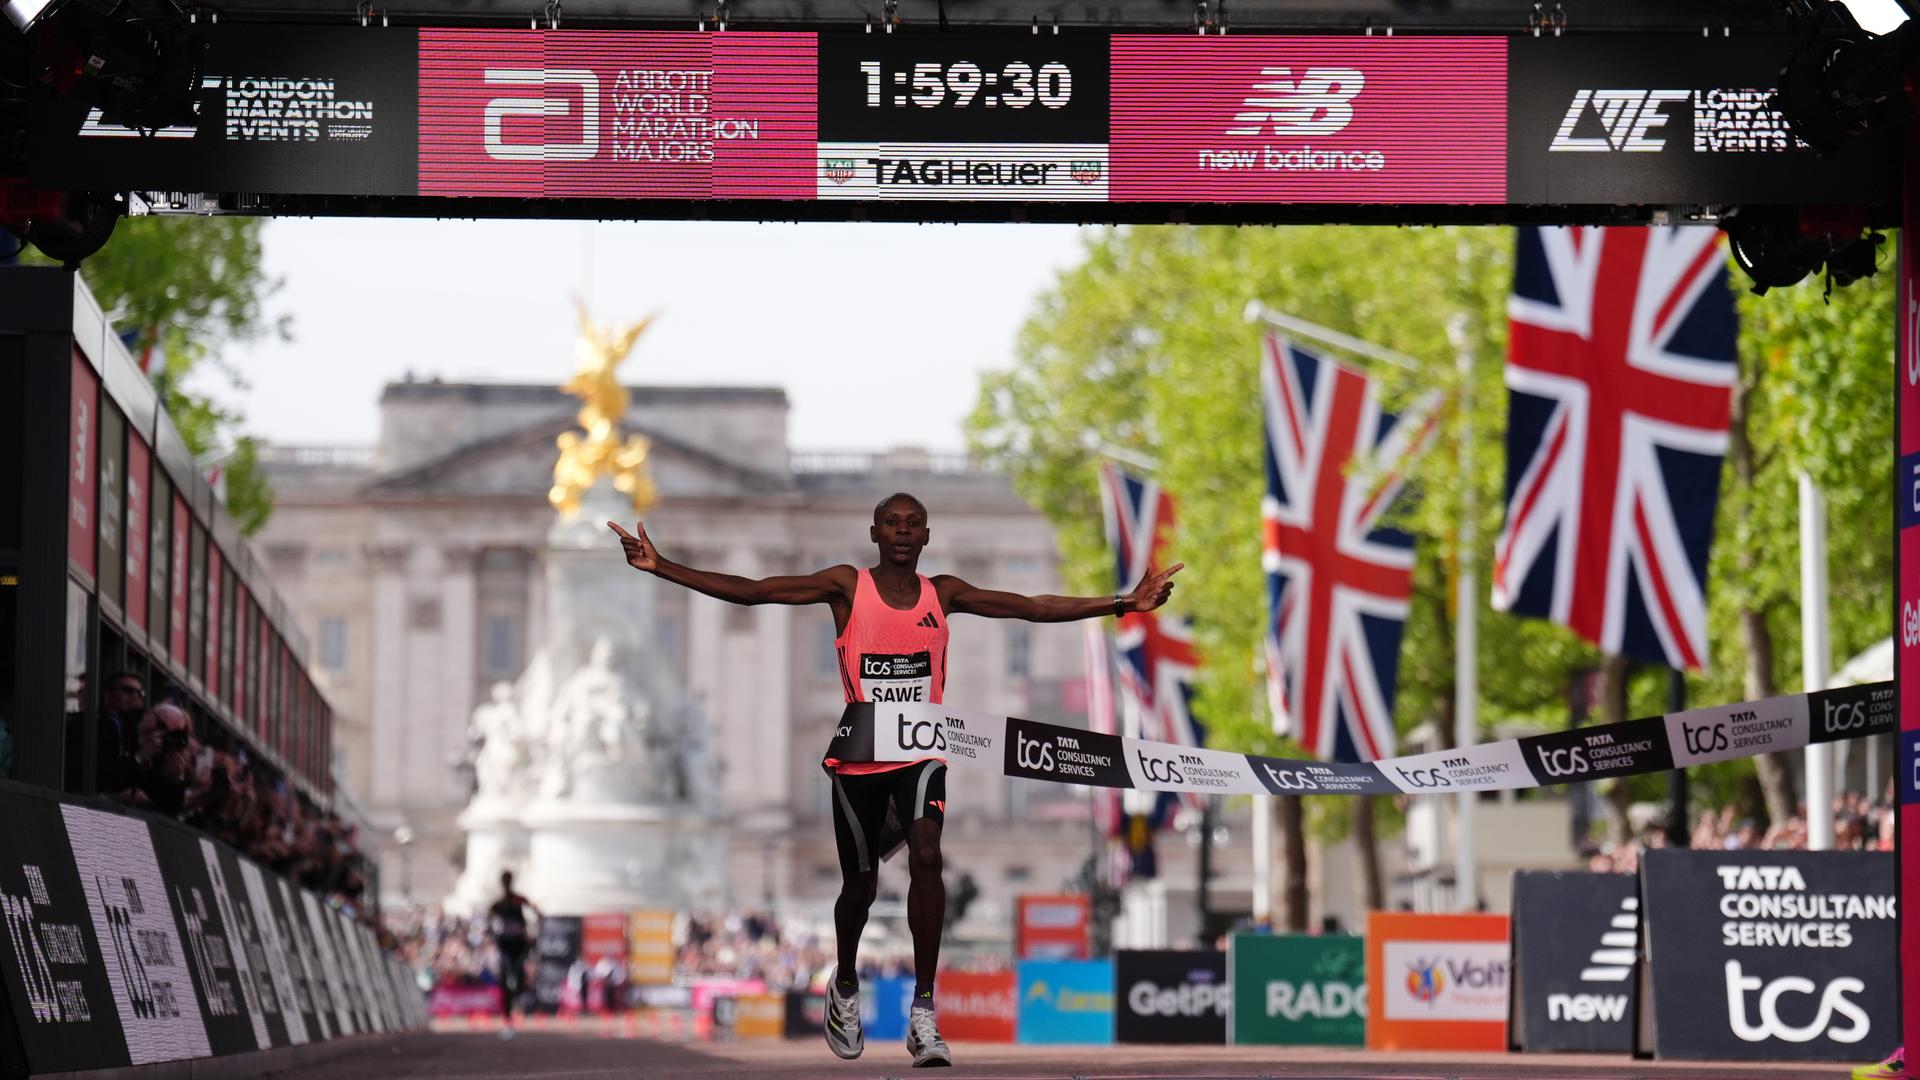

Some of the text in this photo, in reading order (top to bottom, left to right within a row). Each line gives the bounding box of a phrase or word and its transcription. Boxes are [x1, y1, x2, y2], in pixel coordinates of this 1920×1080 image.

[226, 76, 335, 98] LONDON
[613, 69, 714, 91] ABBOTT
[861, 61, 1072, 108] 1:59:30
[226, 100, 373, 119] MARATHON
[612, 93, 709, 115] WORLD
[612, 117, 759, 140] MARATHON
[1694, 110, 1791, 129] MARAT
[226, 120, 320, 141] EVENTS
[1694, 130, 1788, 152] EVENTS
[612, 141, 715, 162] MAJORS
[1199, 145, 1385, 171] new balance
[865, 657, 891, 675] tcs
[872, 686, 923, 702] SAWE
[945, 716, 965, 730] TATA
[1729, 710, 1758, 723] TATA
[1824, 699, 1865, 733] tcs
[898, 713, 947, 751] tcs
[1731, 717, 1794, 737] CONSULTANCY
[947, 730, 992, 748] CONSULTANCY
[1056, 736, 1080, 750] TATA
[1585, 733, 1614, 747] TATA
[1682, 721, 1729, 755] tcs
[1733, 733, 1773, 749] SERVICES
[949, 743, 977, 759] SERVICES
[1017, 730, 1054, 772] tcs
[1056, 749, 1112, 767] CONSULTANCY
[1178, 754, 1204, 766] TATA
[1589, 740, 1652, 760] CONSULTANCY
[1058, 763, 1096, 777] SERVICES
[1137, 749, 1184, 784] tcs
[1441, 757, 1471, 769] TATA
[1448, 762, 1510, 778] CONSULTANCY
[1537, 745, 1590, 776] tcs
[1593, 756, 1635, 771] SERVICES
[1183, 766, 1241, 779] CONSULTANCY
[1263, 763, 1318, 790] tcs
[1305, 766, 1335, 776] TATA
[1395, 766, 1452, 788] tcs
[1187, 776, 1228, 788] SERVICES
[1716, 865, 1806, 890] TATA
[1722, 922, 1853, 948] SERVICES
[95, 875, 156, 1020] tcs
[1547, 993, 1628, 1022] new
[1725, 959, 1871, 1043] tcs
